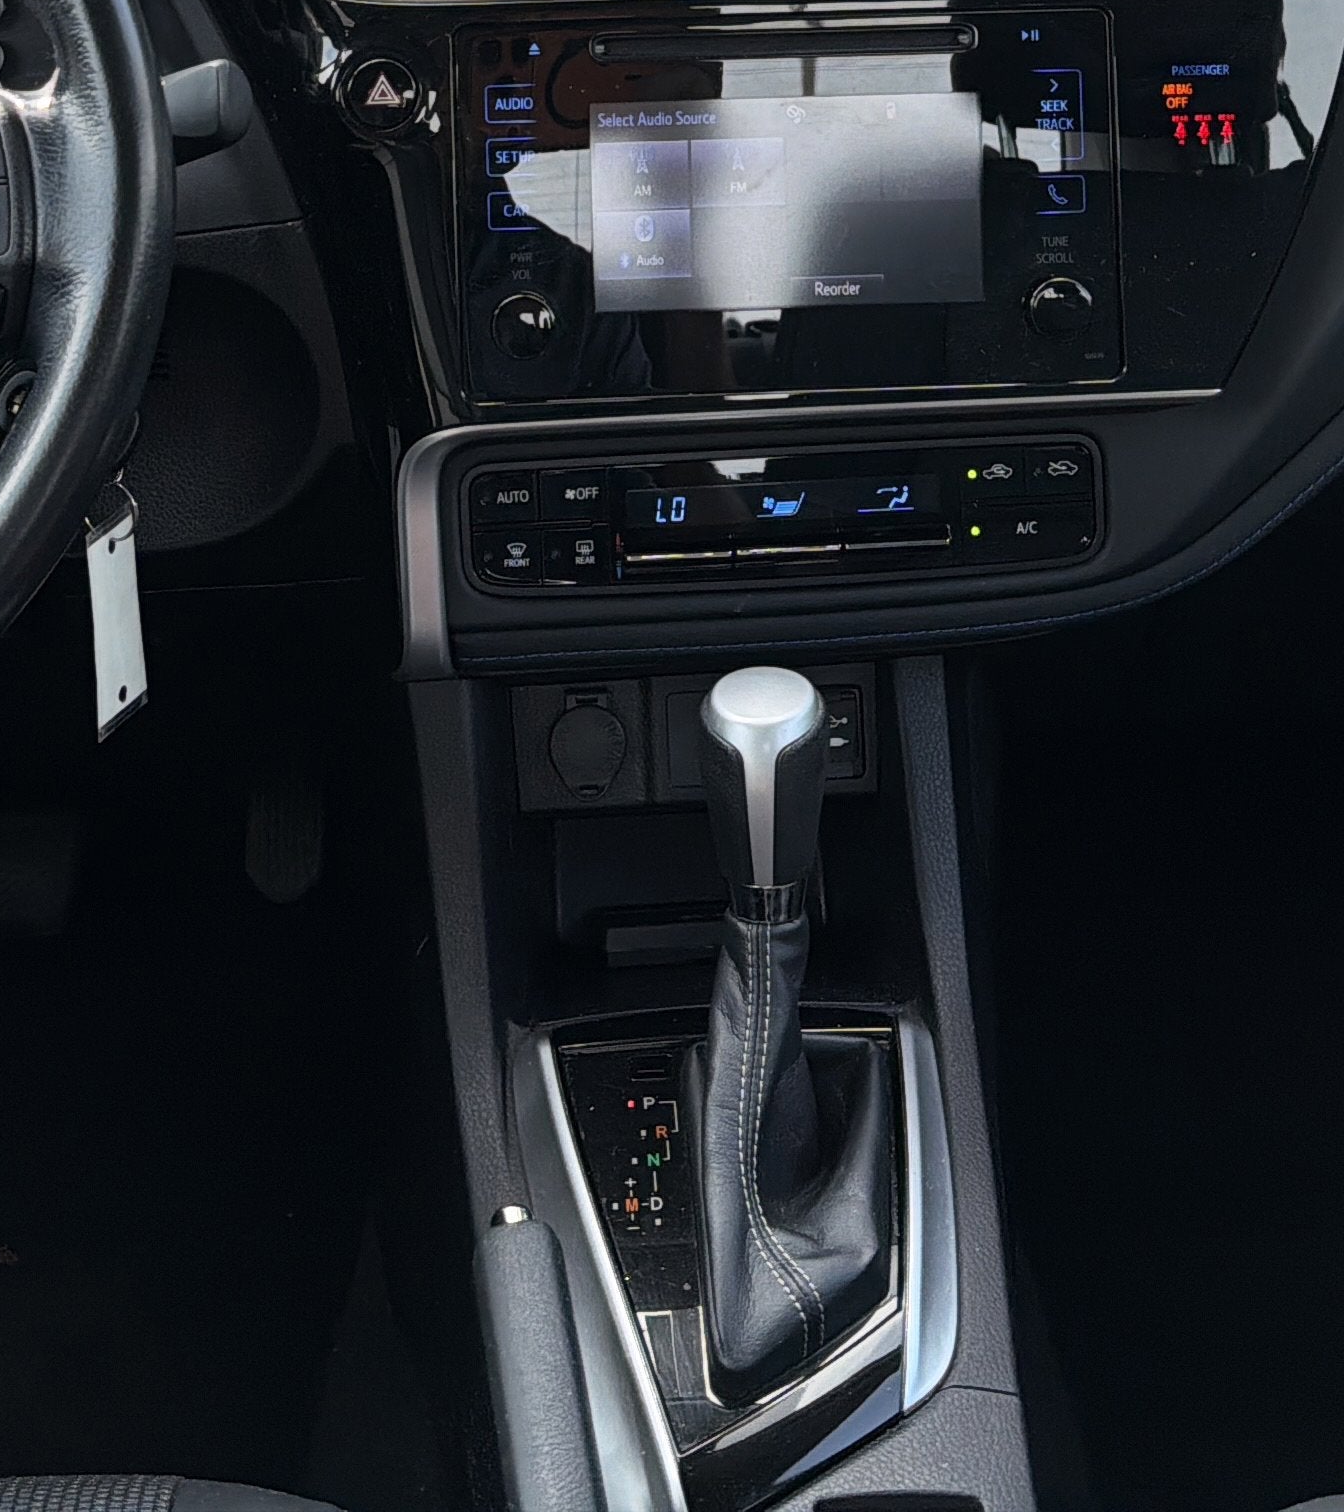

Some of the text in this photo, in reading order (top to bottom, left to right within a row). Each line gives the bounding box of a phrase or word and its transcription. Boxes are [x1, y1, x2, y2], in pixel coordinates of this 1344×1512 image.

[1171, 64, 1230, 76] PASSENGER
[494, 96, 534, 111] AUDIO
[1040, 99, 1068, 113] SEEK
[1165, 96, 1189, 109] OFF
[597, 110, 717, 128] Select Audio Source
[1035, 117, 1074, 131] TRACK
[495, 150, 535, 164] SETUP
[633, 181, 747, 197] AM FM
[503, 203, 531, 218] CAR
[1041, 235, 1069, 248] TUNE
[510, 252, 533, 264] PWR
[636, 254, 664, 267] Audio
[1036, 252, 1074, 264] SCROLL
[511, 269, 533, 281] VOL
[814, 280, 862, 297] Reorder
[496, 489, 530, 505] AUTO
[576, 486, 600, 500] OFF
[1016, 520, 1039, 535] A/C
[503, 557, 531, 568] FRONT
[575, 555, 596, 566] REAR
[642, 1096, 656, 1110] P
[655, 1125, 669, 1139] R
[647, 1153, 661, 1167] N
[625, 1196, 664, 1213] M D
